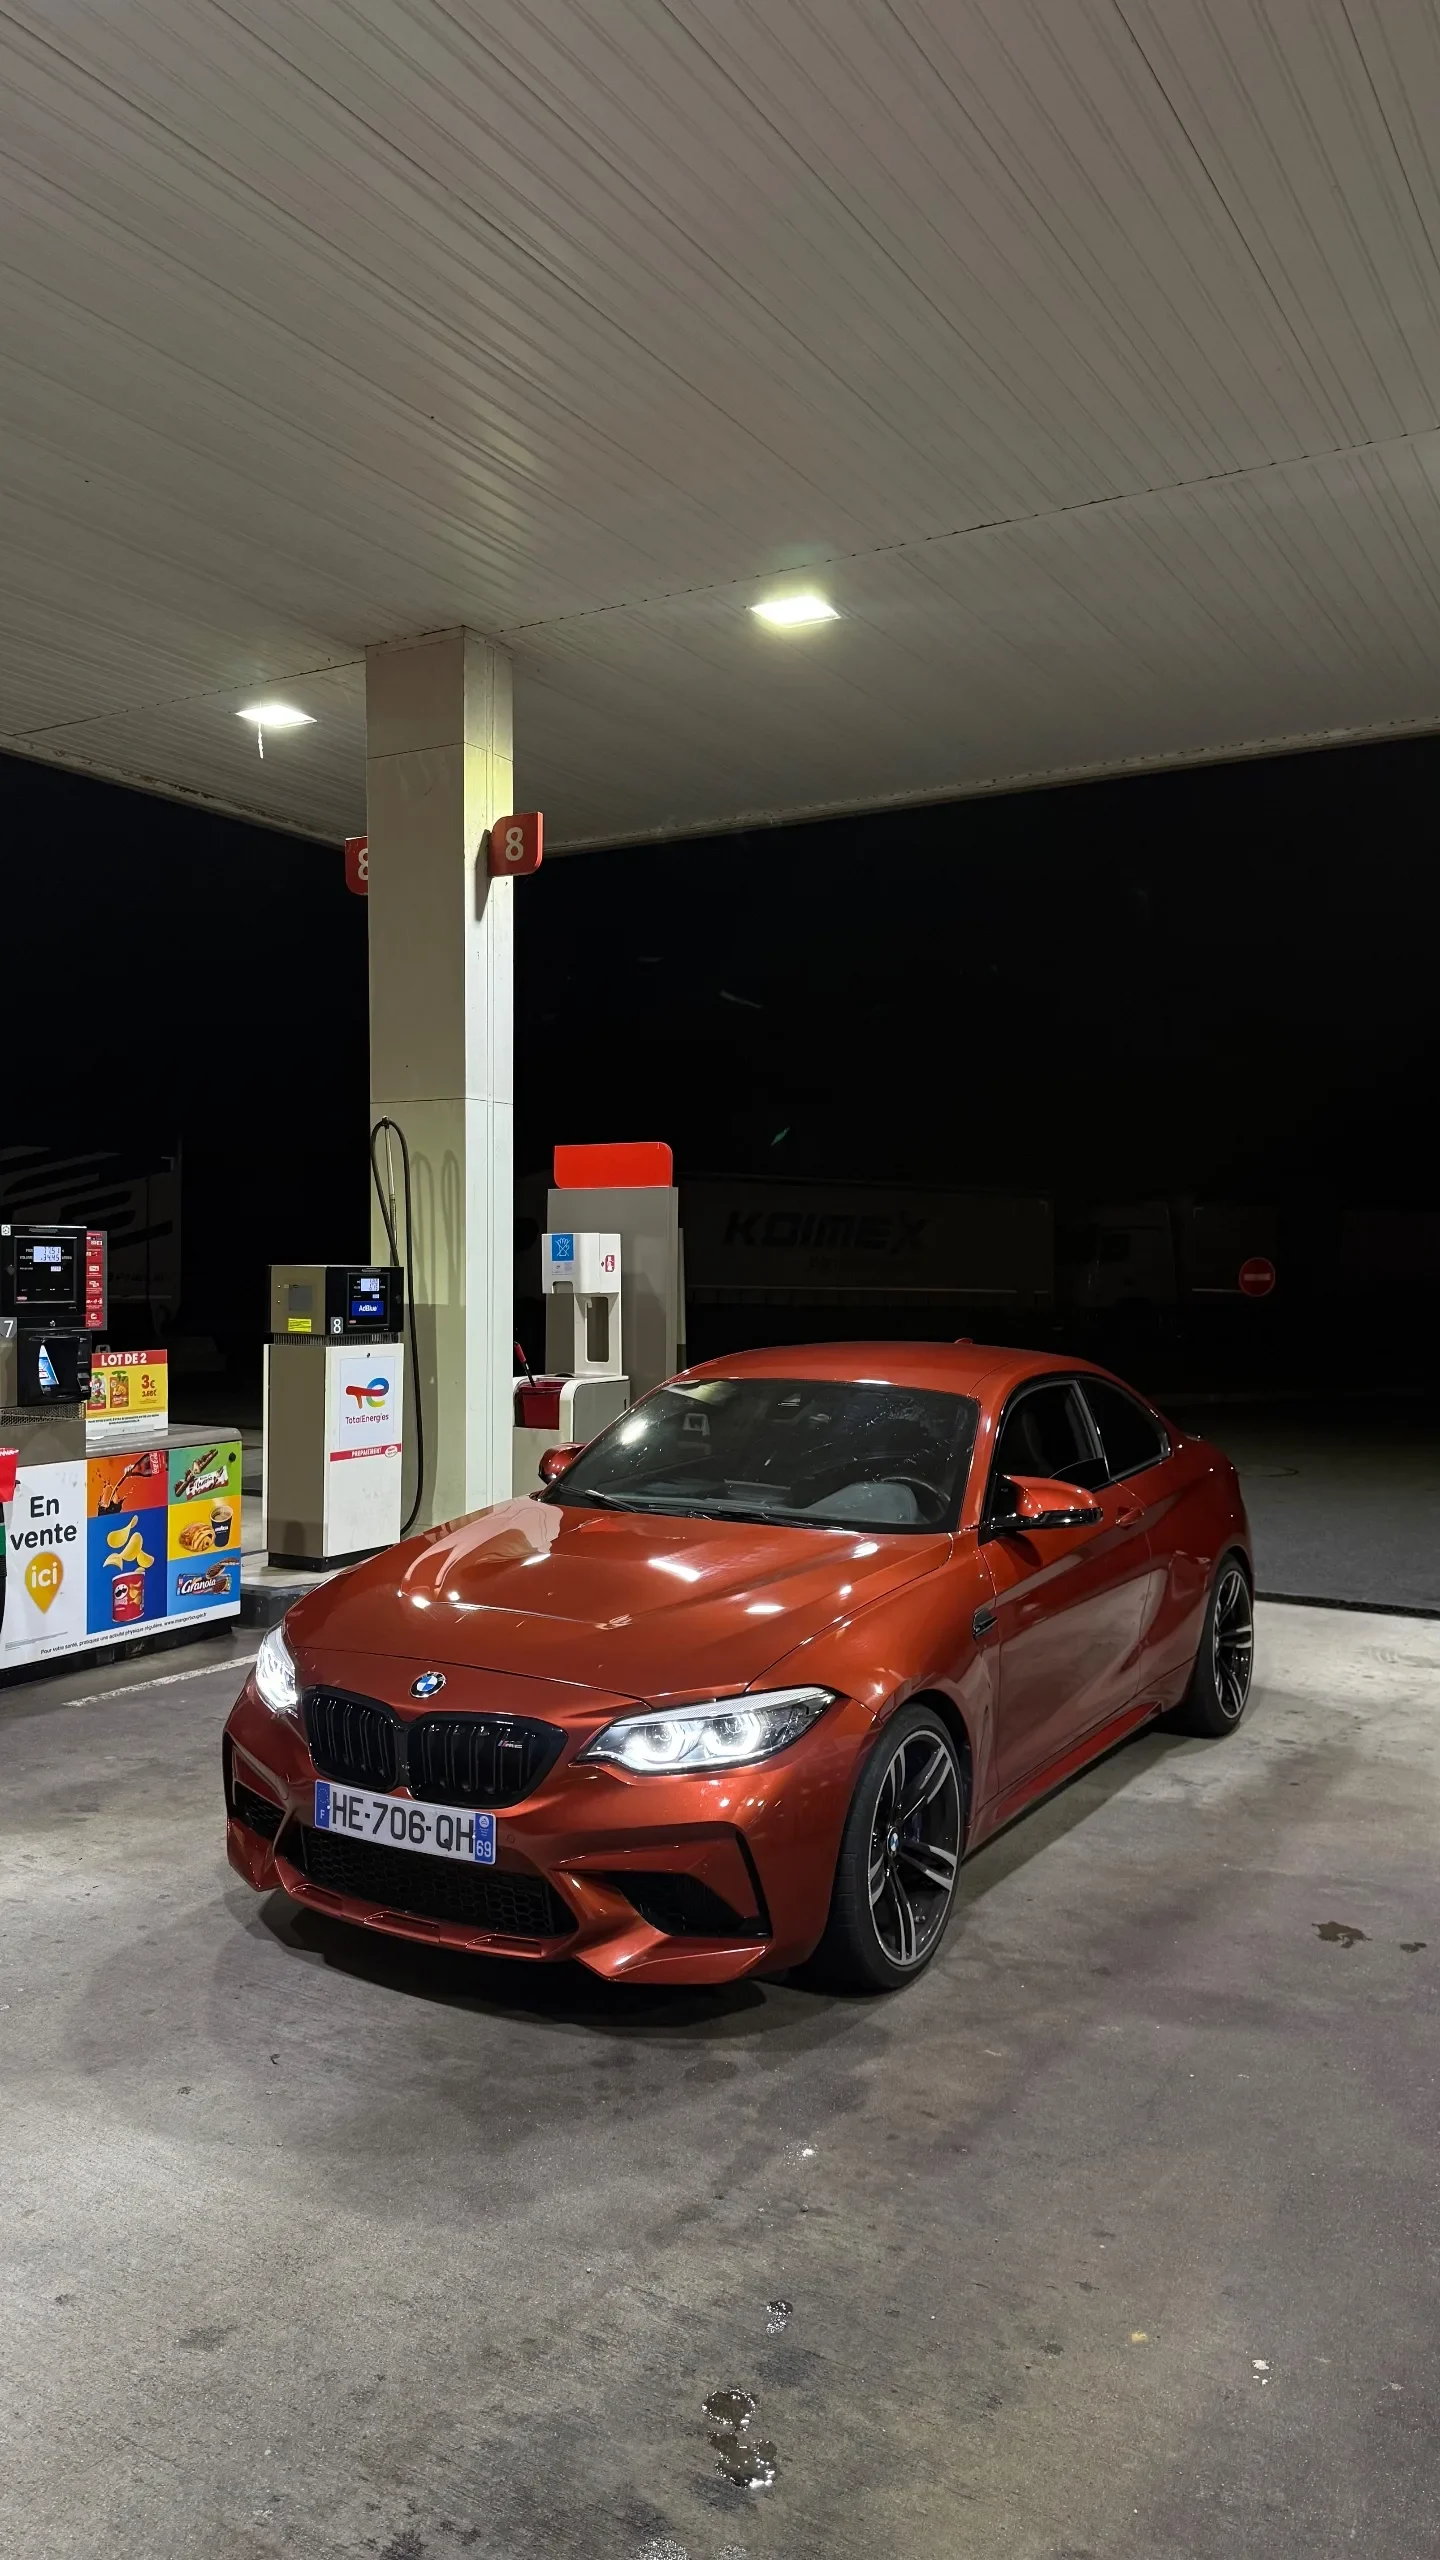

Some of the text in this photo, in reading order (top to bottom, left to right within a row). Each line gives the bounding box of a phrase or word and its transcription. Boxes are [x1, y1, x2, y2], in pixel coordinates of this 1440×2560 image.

[505, 827, 524, 861] 8
[358, 1304, 378, 1312] AdBlue
[3, 1320, 14, 1338] 7
[333, 1318, 341, 1333] 8
[101, 1352, 147, 1367] LOT DE 2
[345, 1413, 389, 1424] TotalEnergies
[30, 1495, 60, 1518] En
[10, 1523, 77, 1550] vente
[31, 1561, 58, 1588] ici
[181, 1578, 216, 1594] Granola
[319, 1809, 325, 1819] F
[332, 1791, 474, 1854] HE-706-QH
[476, 1839, 492, 1858] 69
